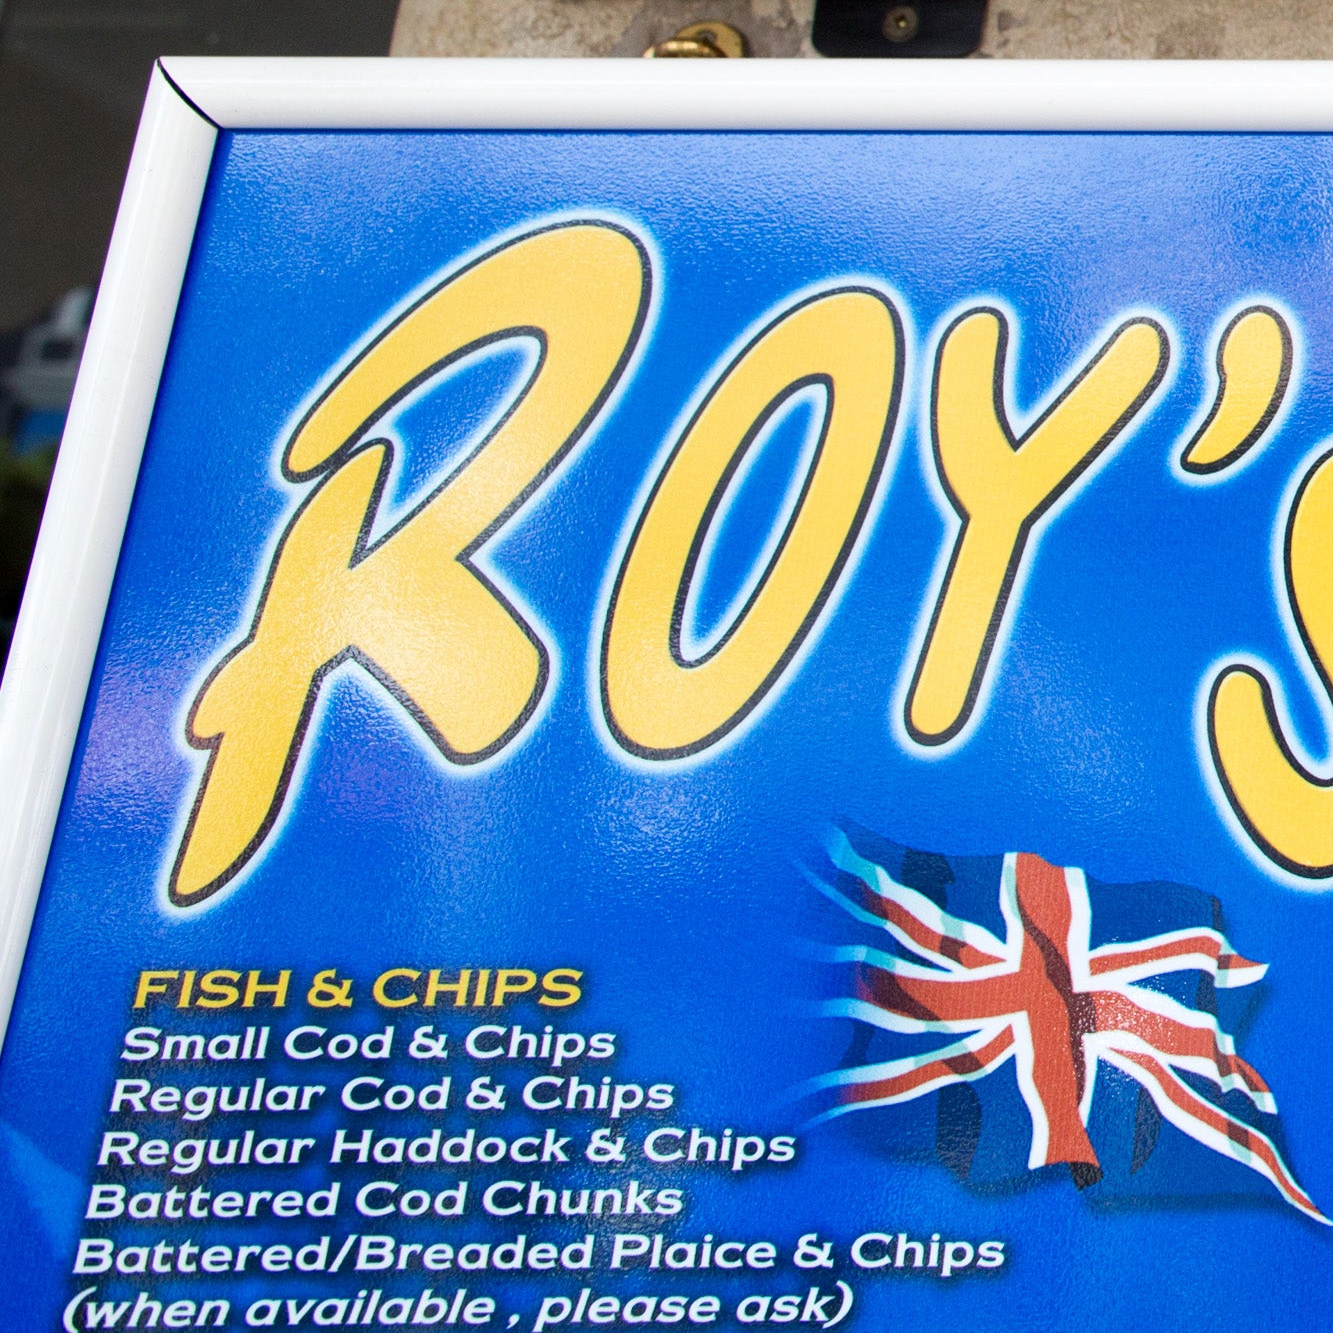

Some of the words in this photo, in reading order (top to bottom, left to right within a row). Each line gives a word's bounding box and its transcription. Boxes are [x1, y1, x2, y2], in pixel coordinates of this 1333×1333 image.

[133, 969, 291, 1009] FISH
[307, 969, 353, 1008] &
[372, 968, 582, 1008] CHIPS
[120, 1026, 269, 1061] Small
[284, 1025, 394, 1060] Cod
[408, 1025, 447, 1059] &
[465, 1025, 615, 1067] Chips
[110, 1078, 325, 1121] Regular
[341, 1076, 451, 1111] Cod
[465, 1076, 505, 1110] &
[522, 1076, 674, 1118] Chips
[97, 1131, 315, 1175] Regular
[330, 1129, 570, 1163] Haddock
[585, 1128, 625, 1163] &
[643, 1127, 794, 1171] Chips
[85, 1182, 340, 1219] Battered
[356, 1181, 467, 1217] Cod
[483, 1180, 683, 1216] Chunks
[73, 1235, 594, 1274] Battered/Breaded
[610, 1234, 776, 1269] Plaice
[793, 1234, 833, 1268] &
[850, 1233, 1004, 1277] Chips
[63, 1287, 230, 1333] (when
[245, 1289, 495, 1326] available
[532, 1288, 720, 1333] please
[736, 1280, 853, 1329] ask)
